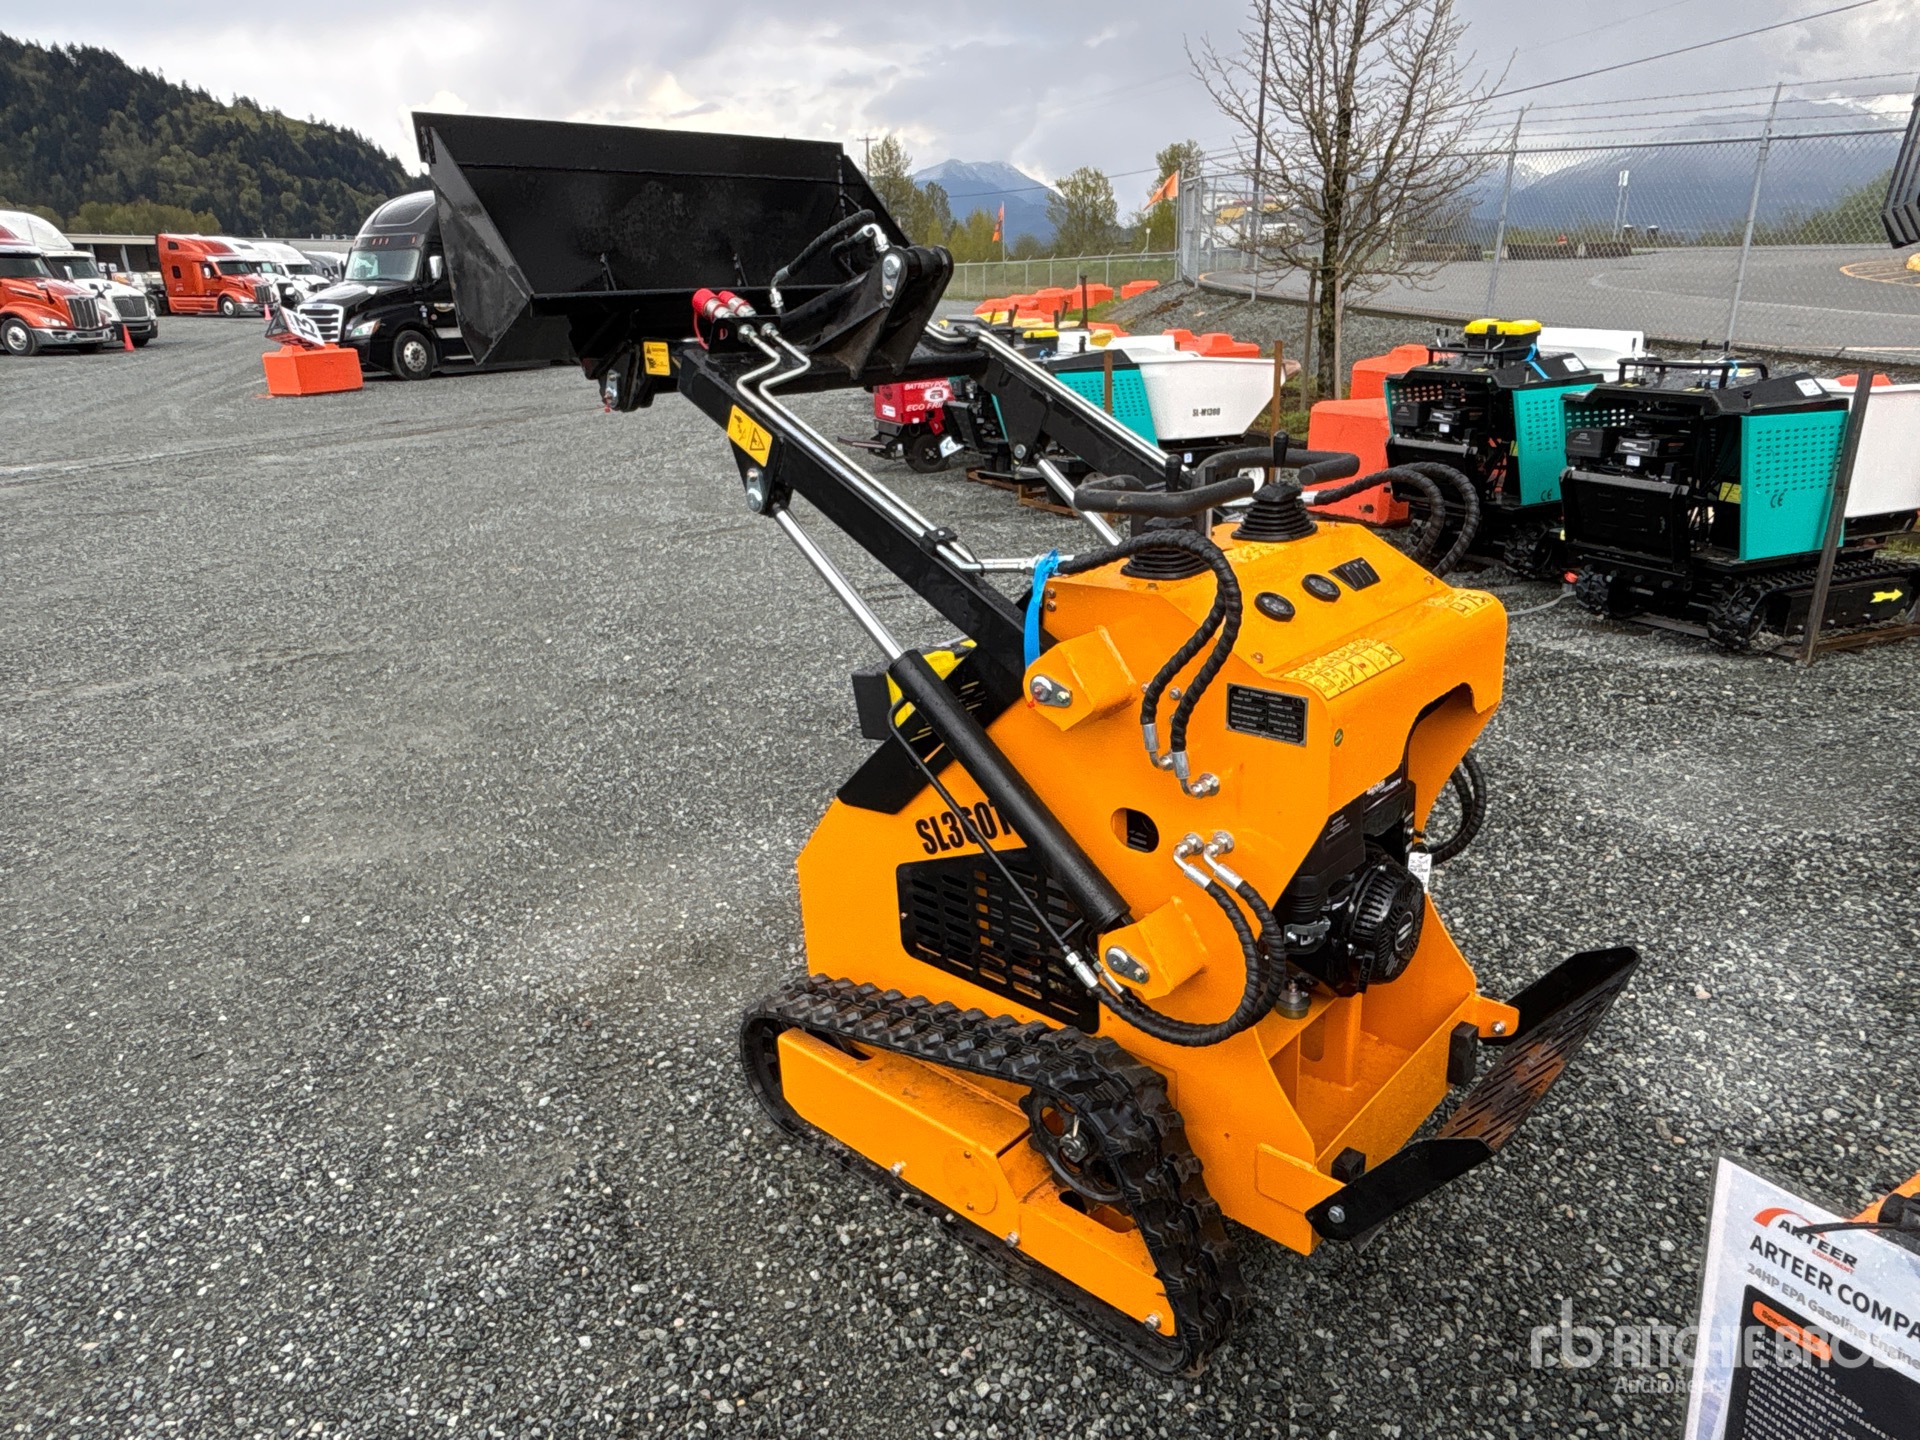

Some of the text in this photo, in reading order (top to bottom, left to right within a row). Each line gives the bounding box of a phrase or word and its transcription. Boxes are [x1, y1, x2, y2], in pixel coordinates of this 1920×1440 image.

[905, 382, 933, 390] BATTERY
[906, 403, 926, 413] ECO
[1770, 492, 1785, 508] CE
[1750, 1235, 1833, 1295] ARTEER
[1812, 1249, 1854, 1275] EQUIPMENT
[1747, 1263, 1920, 1370] 24HP EPA Gasoline Engine
